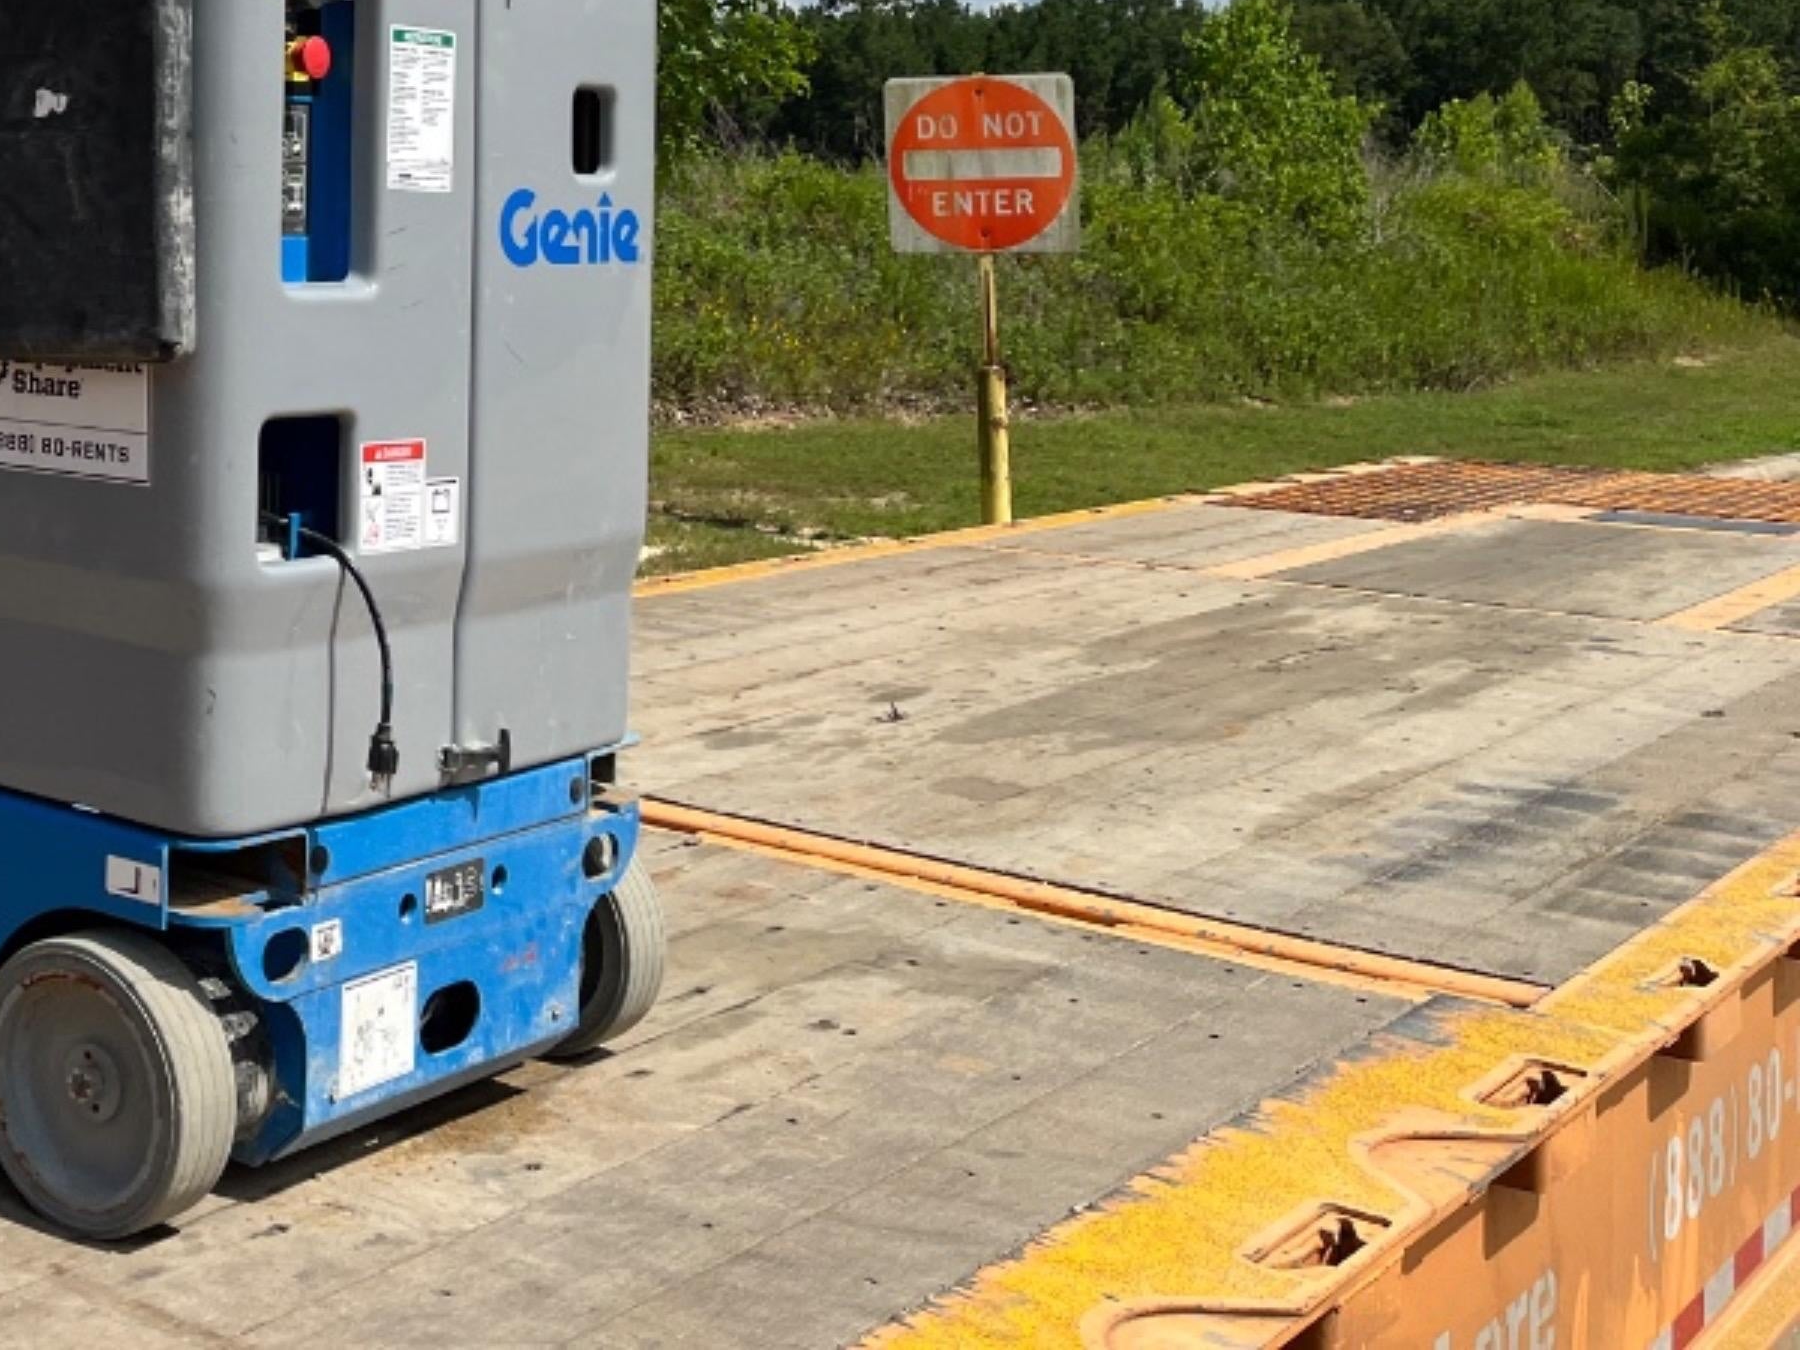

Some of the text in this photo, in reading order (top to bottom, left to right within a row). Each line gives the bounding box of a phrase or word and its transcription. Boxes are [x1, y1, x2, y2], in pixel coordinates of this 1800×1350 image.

[916, 110, 1042, 140] DO NOT
[932, 188, 1035, 218] ENTER
[500, 187, 640, 268] Genie
[12, 369, 82, 399] Share
[40, 437, 130, 463] 80-RENTS
[1647, 1080, 1740, 1263] (888)
